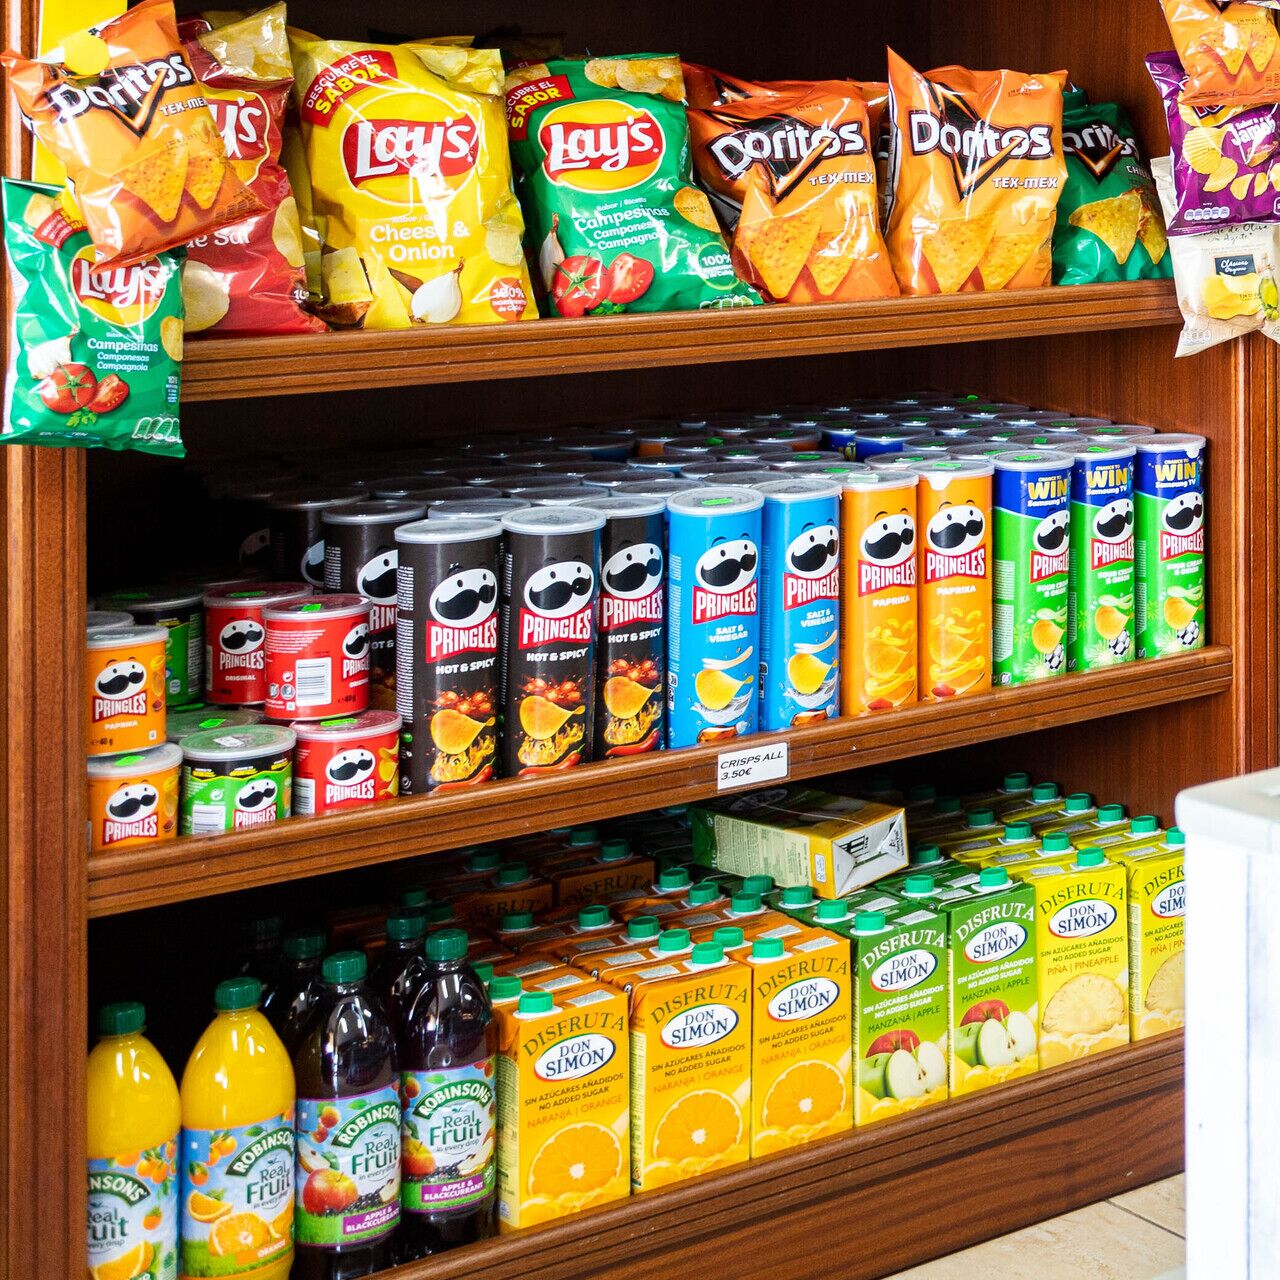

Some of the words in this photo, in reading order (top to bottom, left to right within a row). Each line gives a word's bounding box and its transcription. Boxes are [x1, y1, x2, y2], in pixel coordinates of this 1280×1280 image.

[56, 56, 191, 116] Doritos
[549, 117, 655, 171] Lay's
[910, 108, 1052, 158] Doritos
[710, 122, 865, 175] Doritos
[808, 171, 875, 187] TEX-MEX
[992, 176, 1059, 189] TEX-MEX
[388, 240, 456, 263] Onion
[87, 336, 159, 354] Campesinas
[1086, 468, 1128, 490] WIN
[1155, 463, 1198, 485] WIN
[860, 563, 917, 592] PRINGLES
[927, 552, 986, 580] PRINGLES
[787, 579, 840, 607] PRINGLES
[872, 593, 911, 608] PAPRIKA
[936, 584, 977, 596] PAPRIKA
[603, 597, 663, 625] PRINGLES
[696, 591, 758, 621] PRINGLES
[430, 620, 498, 651] PRINGLES
[521, 612, 592, 643] PRINGLES
[708, 630, 749, 644] VINEGAR
[716, 626, 737, 636] SALT
[435, 662, 461, 675] HOT
[526, 650, 553, 663] HOT
[93, 690, 147, 717] PRINGLES
[720, 753, 760, 770] CRISPS
[761, 750, 784, 761] ALL
[720, 766, 752, 780] 3.50€
[325, 778, 374, 801] PRINGLES
[104, 816, 158, 841] PRINGLES
[1039, 881, 1125, 917] DISFRUTA
[956, 902, 1036, 942] DISFRUTA
[1057, 912, 1109, 936] SIMON
[1069, 904, 1095, 920] DON
[983, 926, 1008, 943] DON
[862, 928, 947, 970] DISFRUTA
[971, 935, 1022, 962] SIMON
[891, 953, 917, 970] DON
[757, 958, 848, 999] DISFRUTA
[879, 962, 932, 988] SIMON
[790, 981, 817, 998] DON
[649, 984, 749, 1025] DISFRUTA
[777, 989, 833, 1016] SIMON
[685, 1008, 714, 1026] DON
[522, 1012, 626, 1056] DISFRUTA
[670, 1016, 731, 1044] SIMON
[544, 1047, 606, 1075] SIMON
[560, 1040, 591, 1058] DON
[442, 1110, 476, 1128] Real
[363, 1135, 394, 1154] Real
[429, 1120, 483, 1147] Fruit
[259, 1164, 288, 1183] Real
